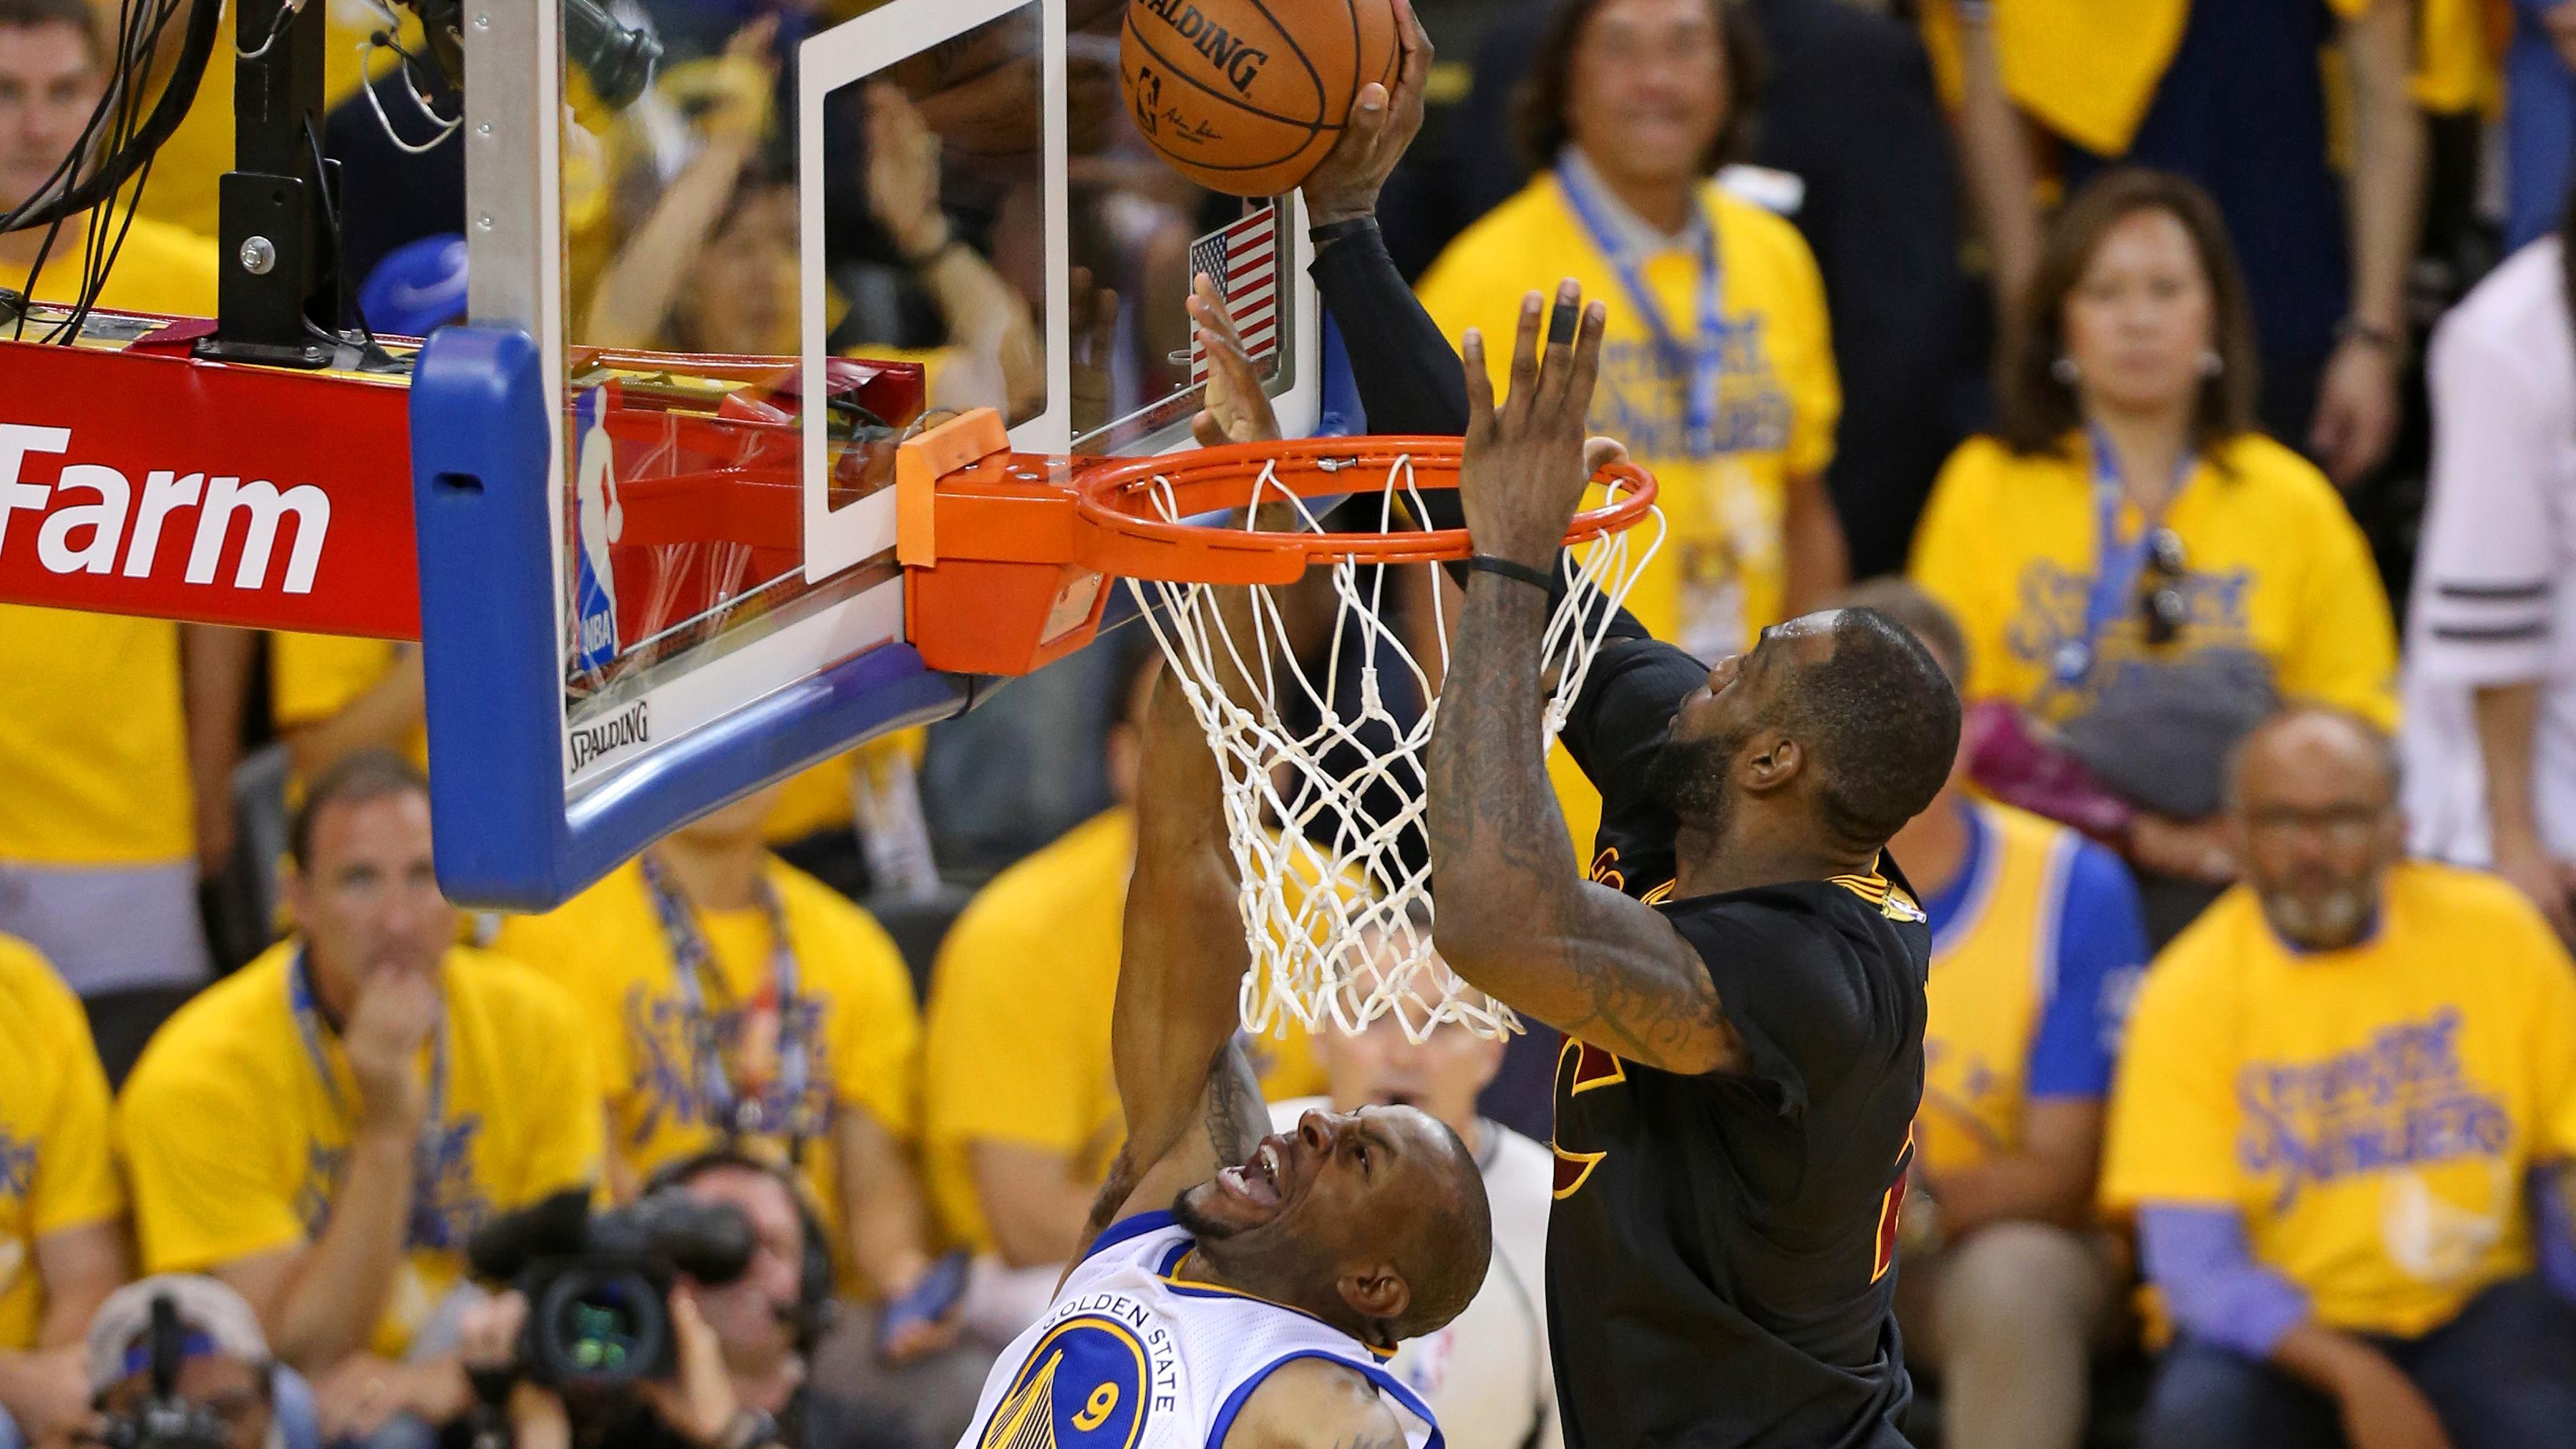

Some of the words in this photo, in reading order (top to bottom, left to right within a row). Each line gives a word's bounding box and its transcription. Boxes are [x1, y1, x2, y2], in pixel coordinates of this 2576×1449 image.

[1137, 0, 1268, 92] ALDING
[0, 423, 331, 593] Farm
[584, 610, 613, 653] NBA
[571, 699, 648, 773] SPALDING
[1043, 1294, 1150, 1329] GOLDEN
[1148, 1329, 1175, 1412] STATE
[1071, 1381, 1120, 1431] 9
